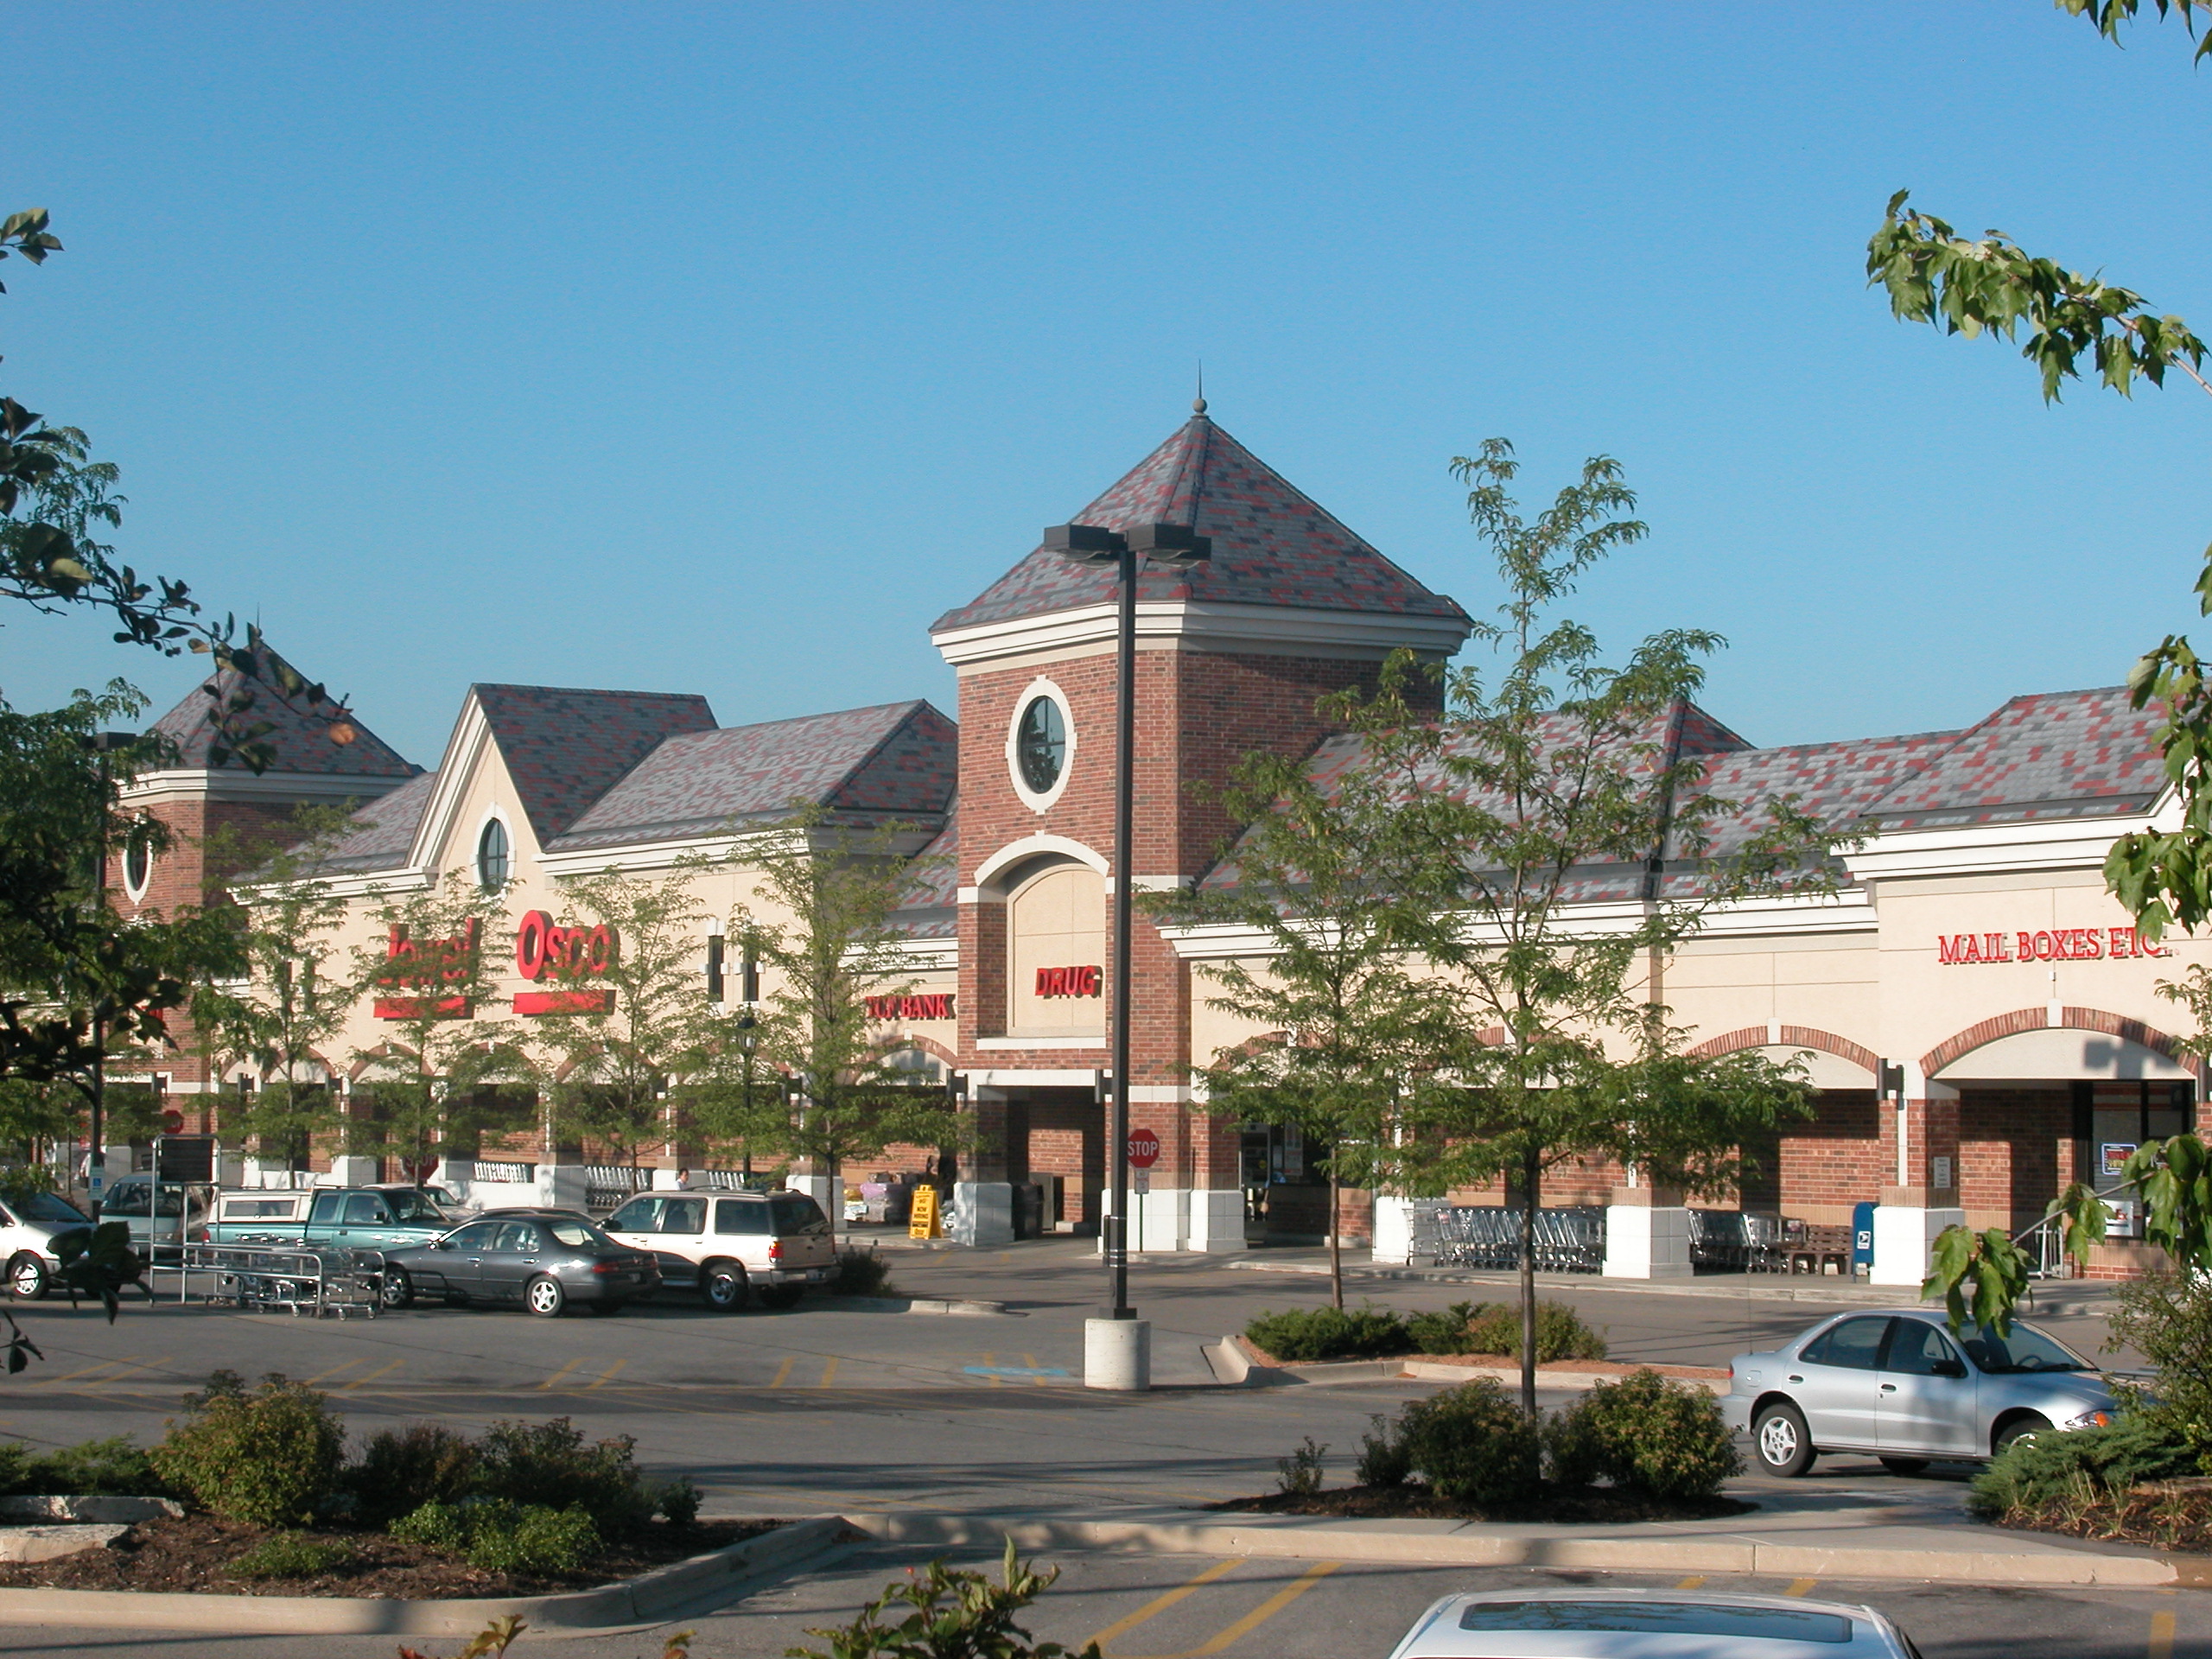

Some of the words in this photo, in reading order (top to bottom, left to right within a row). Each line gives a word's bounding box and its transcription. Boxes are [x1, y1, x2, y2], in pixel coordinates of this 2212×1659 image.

[517, 909, 610, 980] Osco
[1937, 933, 2009, 963] MAIL
[2016, 928, 2101, 959] BOXES
[1035, 965, 1097, 996] DRUG
[899, 994, 949, 1017] BANK
[1128, 1141, 1158, 1156] STOP
